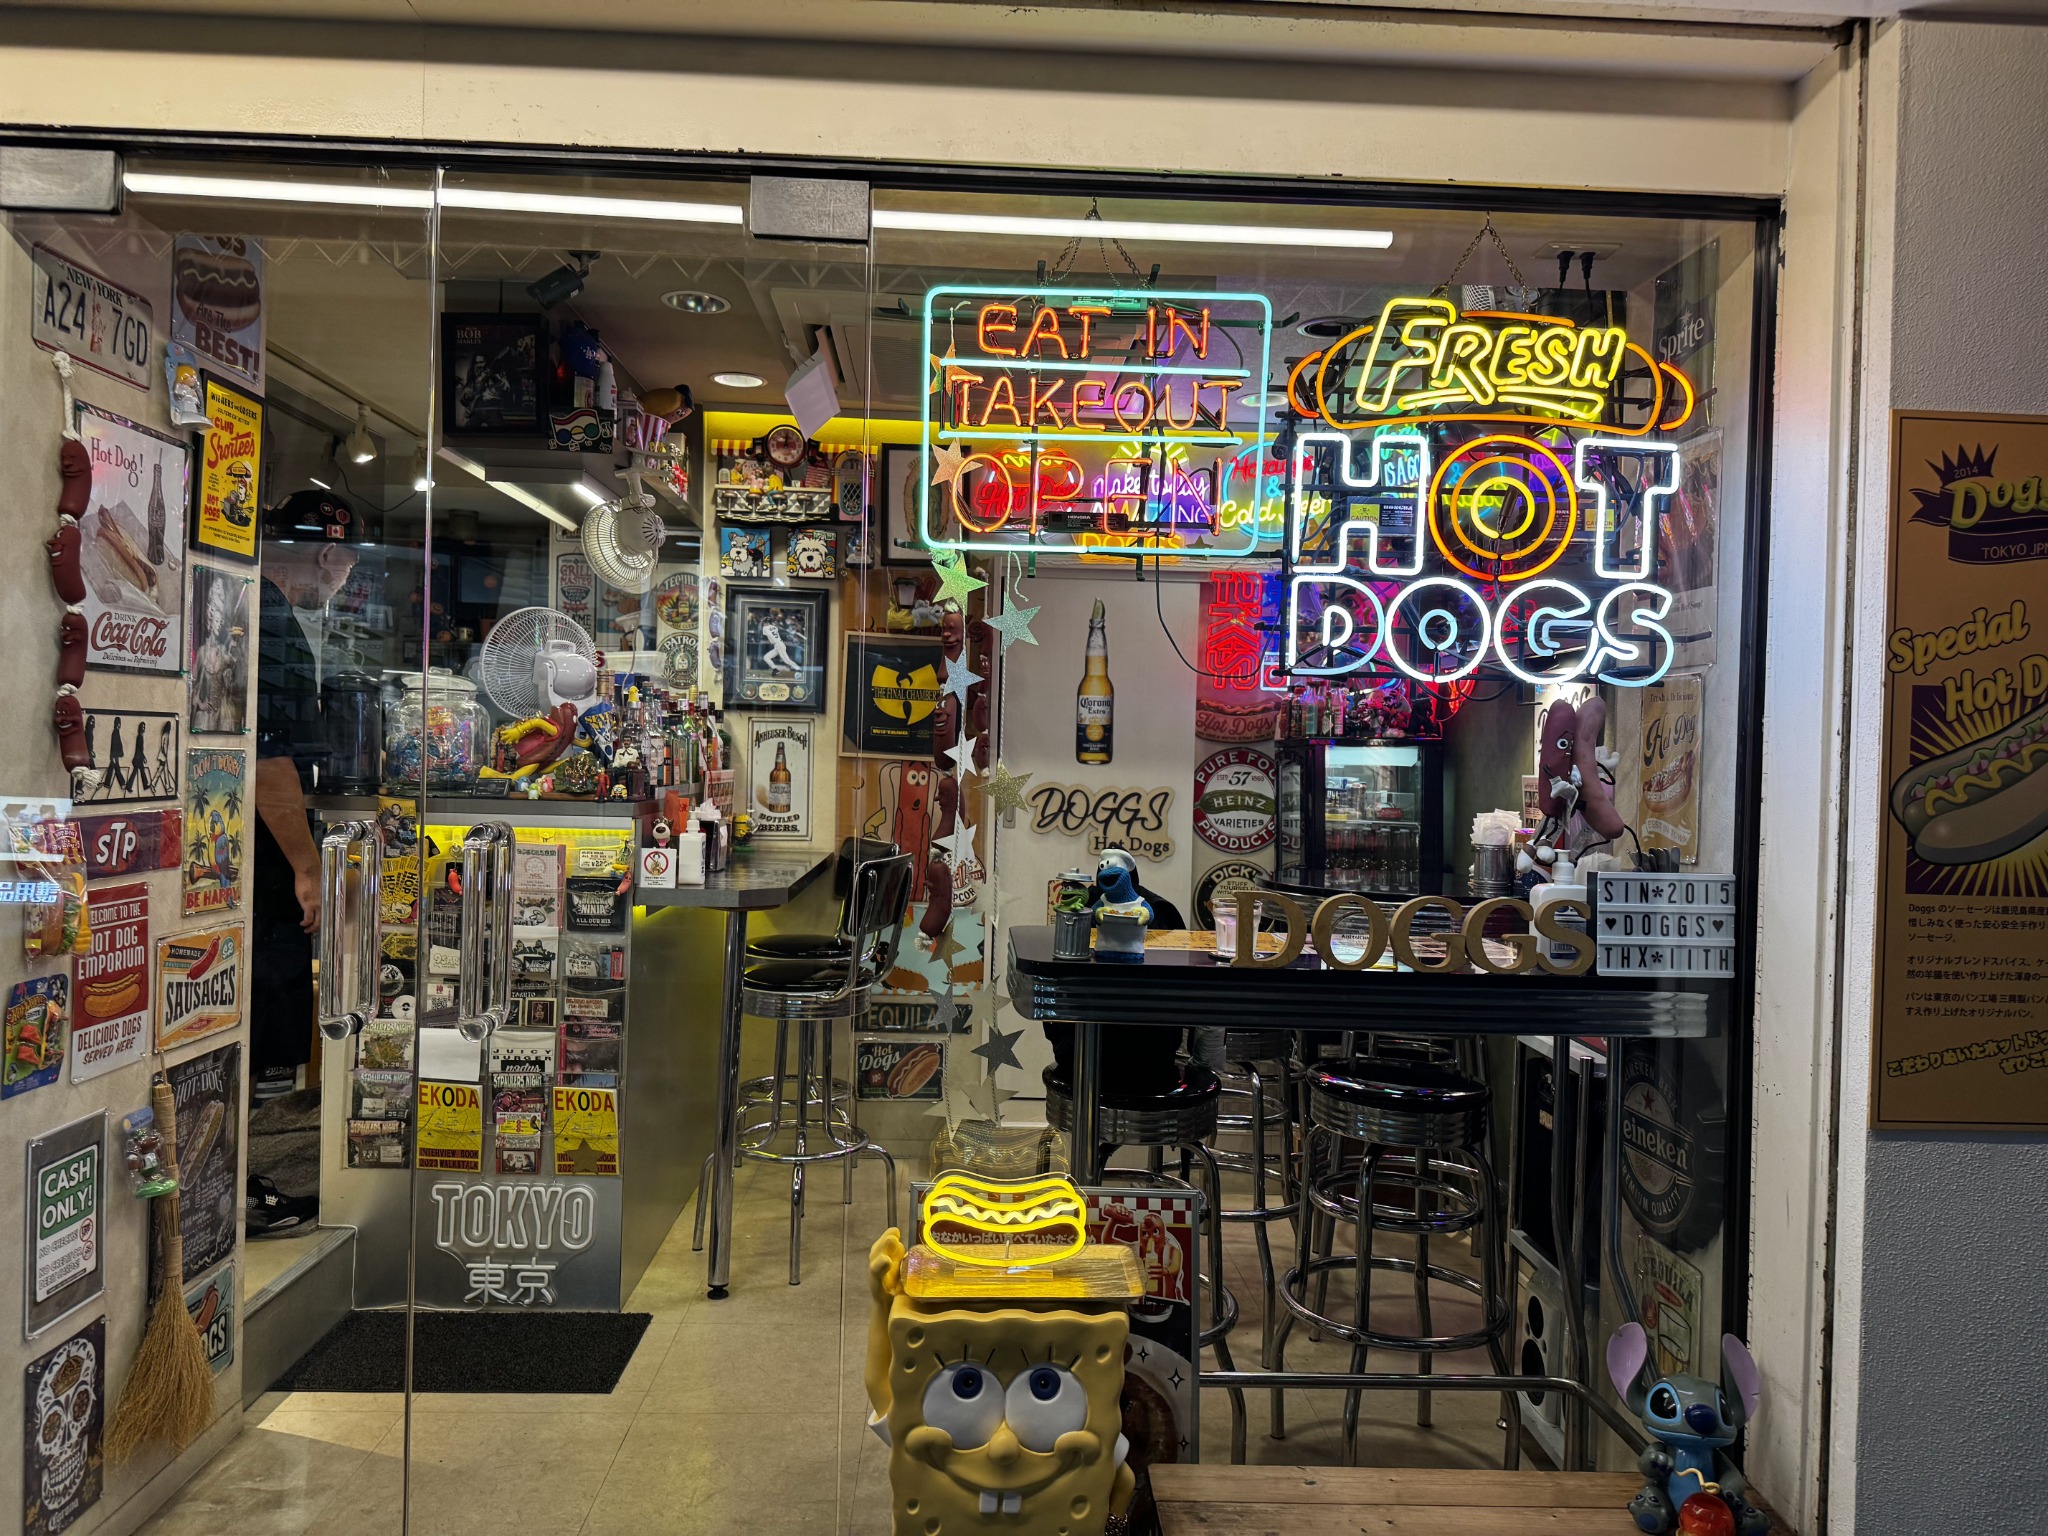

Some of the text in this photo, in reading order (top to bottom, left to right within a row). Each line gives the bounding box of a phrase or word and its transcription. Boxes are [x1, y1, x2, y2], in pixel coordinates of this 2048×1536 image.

[66, 265, 123, 307] NEW YORK
[43, 275, 149, 367] A24 7GD
[978, 304, 1211, 360] EAT IN
[456, 329, 482, 339] BOB
[1658, 316, 1705, 364] Sprite
[194, 320, 261, 375] BEST!
[1355, 297, 1627, 412] FRESH
[950, 374, 1244, 432] TAKEOUT
[214, 416, 235, 435] CLUB
[90, 436, 145, 488] Hot Dog!
[1952, 465, 1979, 480] 2014
[952, 452, 1223, 539] OPEN
[1265, 475, 1283, 498] &
[203, 503, 221, 520] DOGS
[206, 492, 220, 507] HOT
[1291, 433, 1681, 583] HOT
[1219, 497, 1277, 529] Cold
[1585, 519, 1614, 527] CAON
[1981, 545, 2027, 559] TOKYO
[113, 611, 138, 624] DRINK
[1289, 575, 1676, 687] DOGS
[1888, 600, 2031, 676] Special
[886, 688, 906, 700] FINAL
[1080, 696, 1111, 710] Corona
[1944, 665, 2014, 723] Hot
[1087, 706, 1106, 715] Extra
[1195, 711, 1228, 735] Hot
[1228, 716, 1274, 736] Dogs
[754, 728, 787, 749] ANHEUSER
[1643, 711, 1697, 768] Hot Dog
[1195, 751, 1239, 784] PURE
[1228, 771, 1253, 786] 57
[1031, 786, 1170, 836] DOGGS
[1213, 795, 1267, 810] HEINZ
[758, 812, 801, 824] BOTTLED
[1213, 817, 1265, 829] VARIETIES
[95, 820, 137, 868] STP
[1128, 836, 1170, 857] Dogs
[1197, 820, 1276, 850] PRODUCTS
[185, 890, 203, 910] BE
[580, 904, 608, 915] NINJA
[1908, 903, 1936, 915] Doggs
[89, 902, 141, 924] ELCOME TO THE
[115, 925, 138, 950] DOG
[1231, 890, 1598, 976] DOGGS
[1624, 914, 1705, 938] DOGGS
[77, 945, 145, 981] EMPORIUM
[171, 947, 202, 958] HOMEMADE
[165, 964, 236, 1027] SAUSAGES
[77, 1017, 142, 1053] DELICIOUS DOGS
[82, 1037, 136, 1066] SERVED HERE
[859, 1051, 902, 1072] Dogs
[872, 1044, 893, 1058] Hot
[175, 1069, 224, 1108] HOT DOG
[525, 1073, 543, 1088] NIGHT
[418, 1083, 481, 1110] EKODA
[554, 1089, 616, 1113] EKODA
[419, 1148, 480, 1160] INTERVIEW BOOK
[1622, 1116, 1689, 1171] eineken
[419, 1158, 439, 1169] 2023
[44, 1155, 91, 1199] CASH
[42, 1186, 93, 1230] ONLY!
[1651, 1187, 1682, 1217] QUALITY
[432, 1184, 596, 1251] TOKYO
[39, 1244, 51, 1260] NO
[39, 1264, 51, 1279] NO
[463, 1255, 558, 1305] 東京
[202, 1314, 227, 1359] OGS
